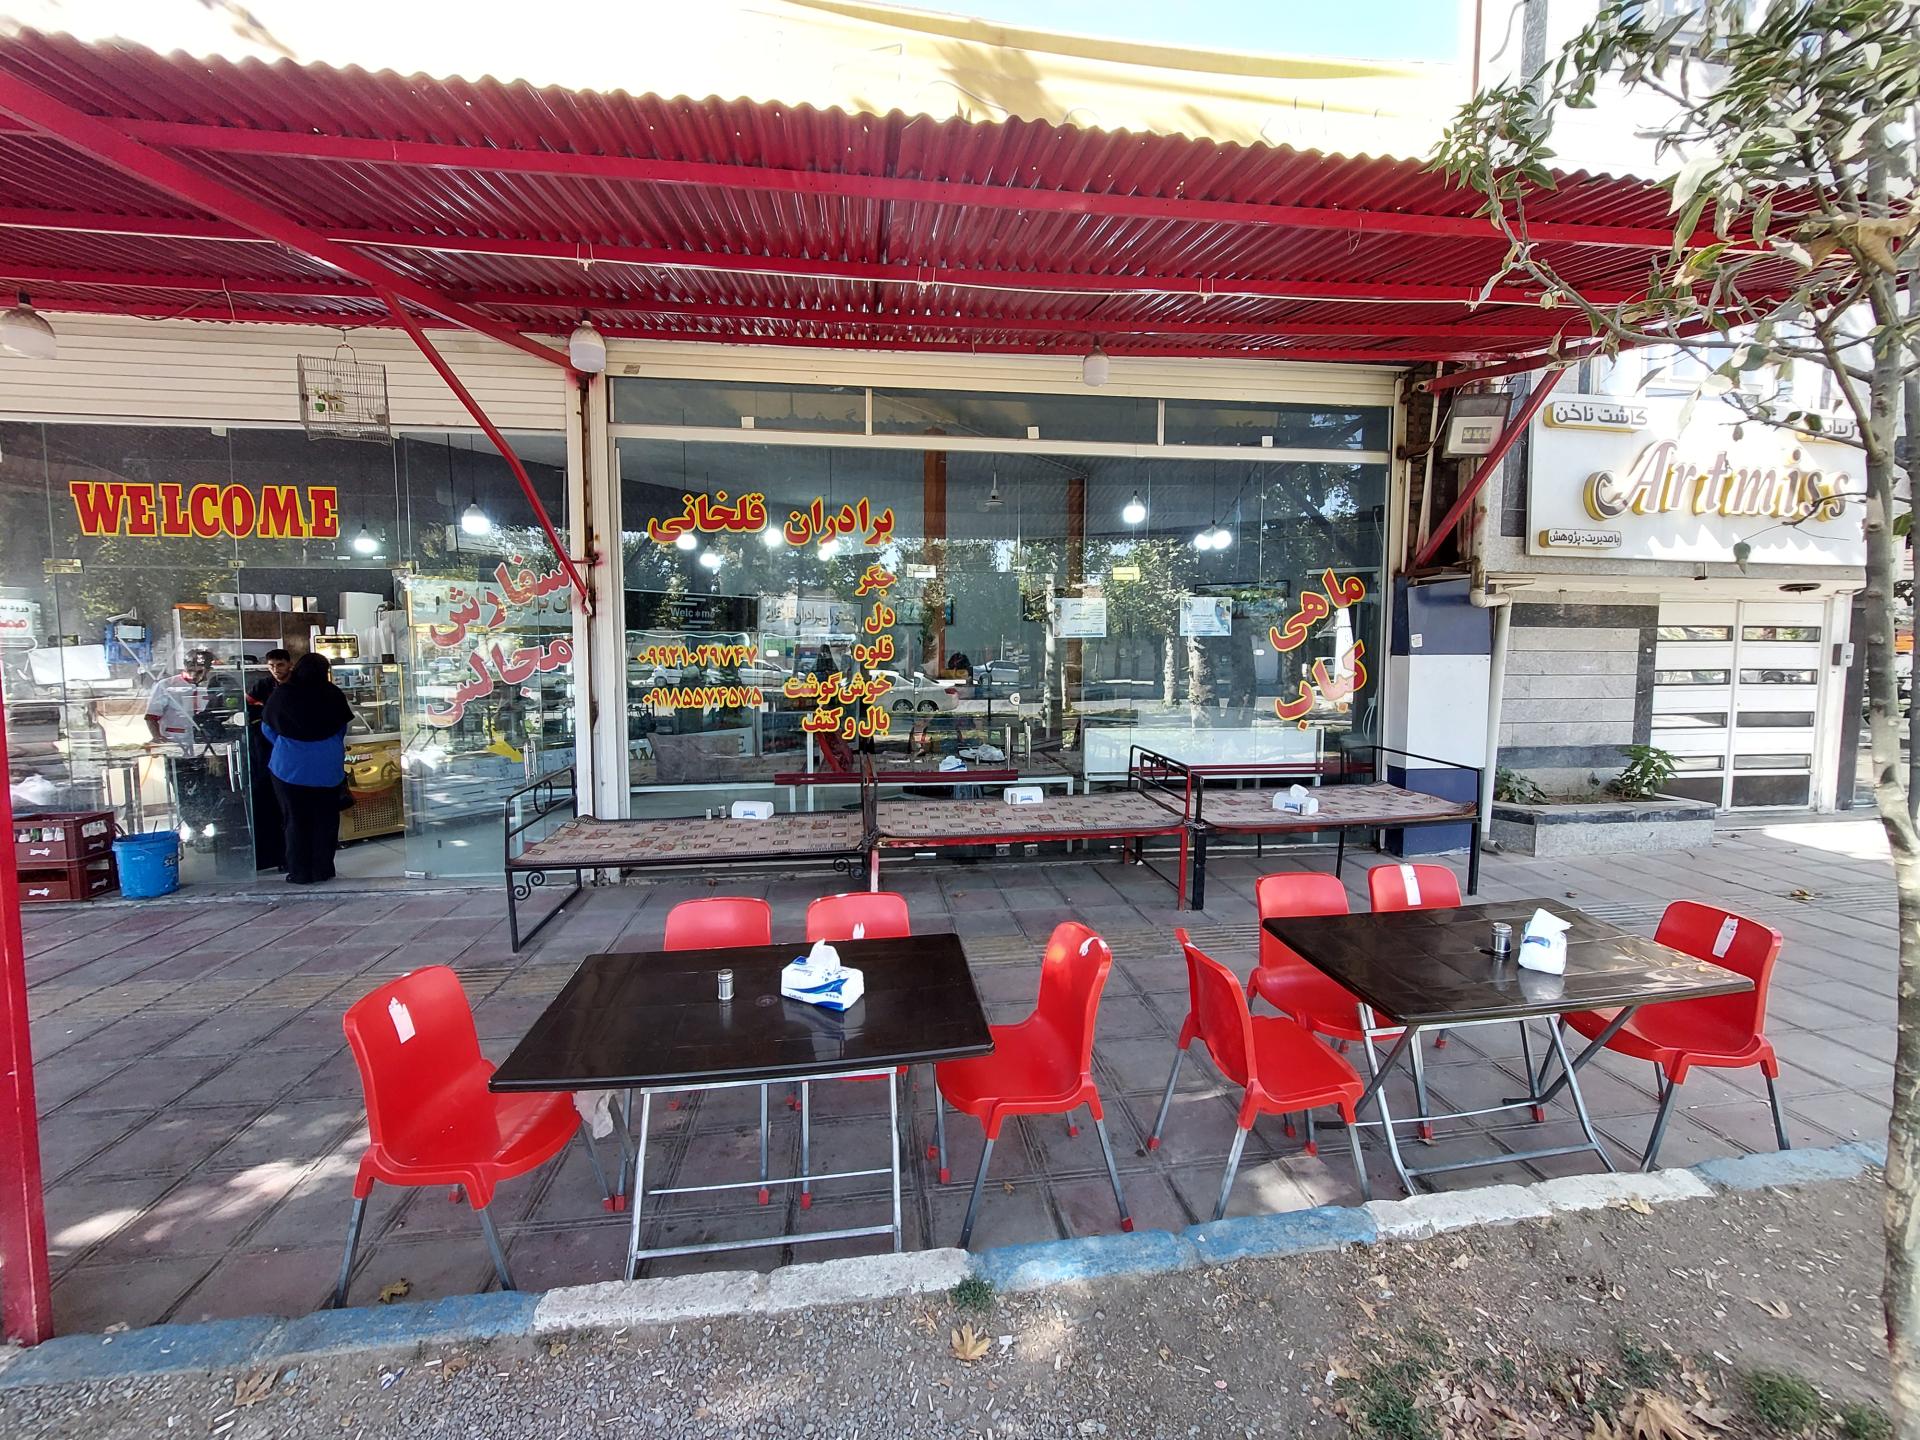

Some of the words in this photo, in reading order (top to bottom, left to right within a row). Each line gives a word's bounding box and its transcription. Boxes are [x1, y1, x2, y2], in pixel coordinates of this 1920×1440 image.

[1556, 403, 1594, 423] ناخن
[1597, 405, 1648, 425] کاشت
[1586, 438, 1851, 521] Artmiss
[69, 481, 340, 538] WELCOME
[648, 489, 767, 544] قلخانی
[784, 496, 894, 545] برادران
[855, 564, 897, 597] جگر
[430, 554, 572, 648] سفارش
[864, 601, 896, 634] دل
[1269, 567, 1366, 652] ماهی
[854, 634, 894, 669] قلوه
[427, 640, 574, 728] مجالس
[784, 672, 842, 704] گوشت
[839, 672, 894, 703] خوش
[1275, 639, 1368, 731] کباب
[802, 706, 843, 733] کتف
[841, 714, 856, 740] و
[858, 706, 891, 737] بال
